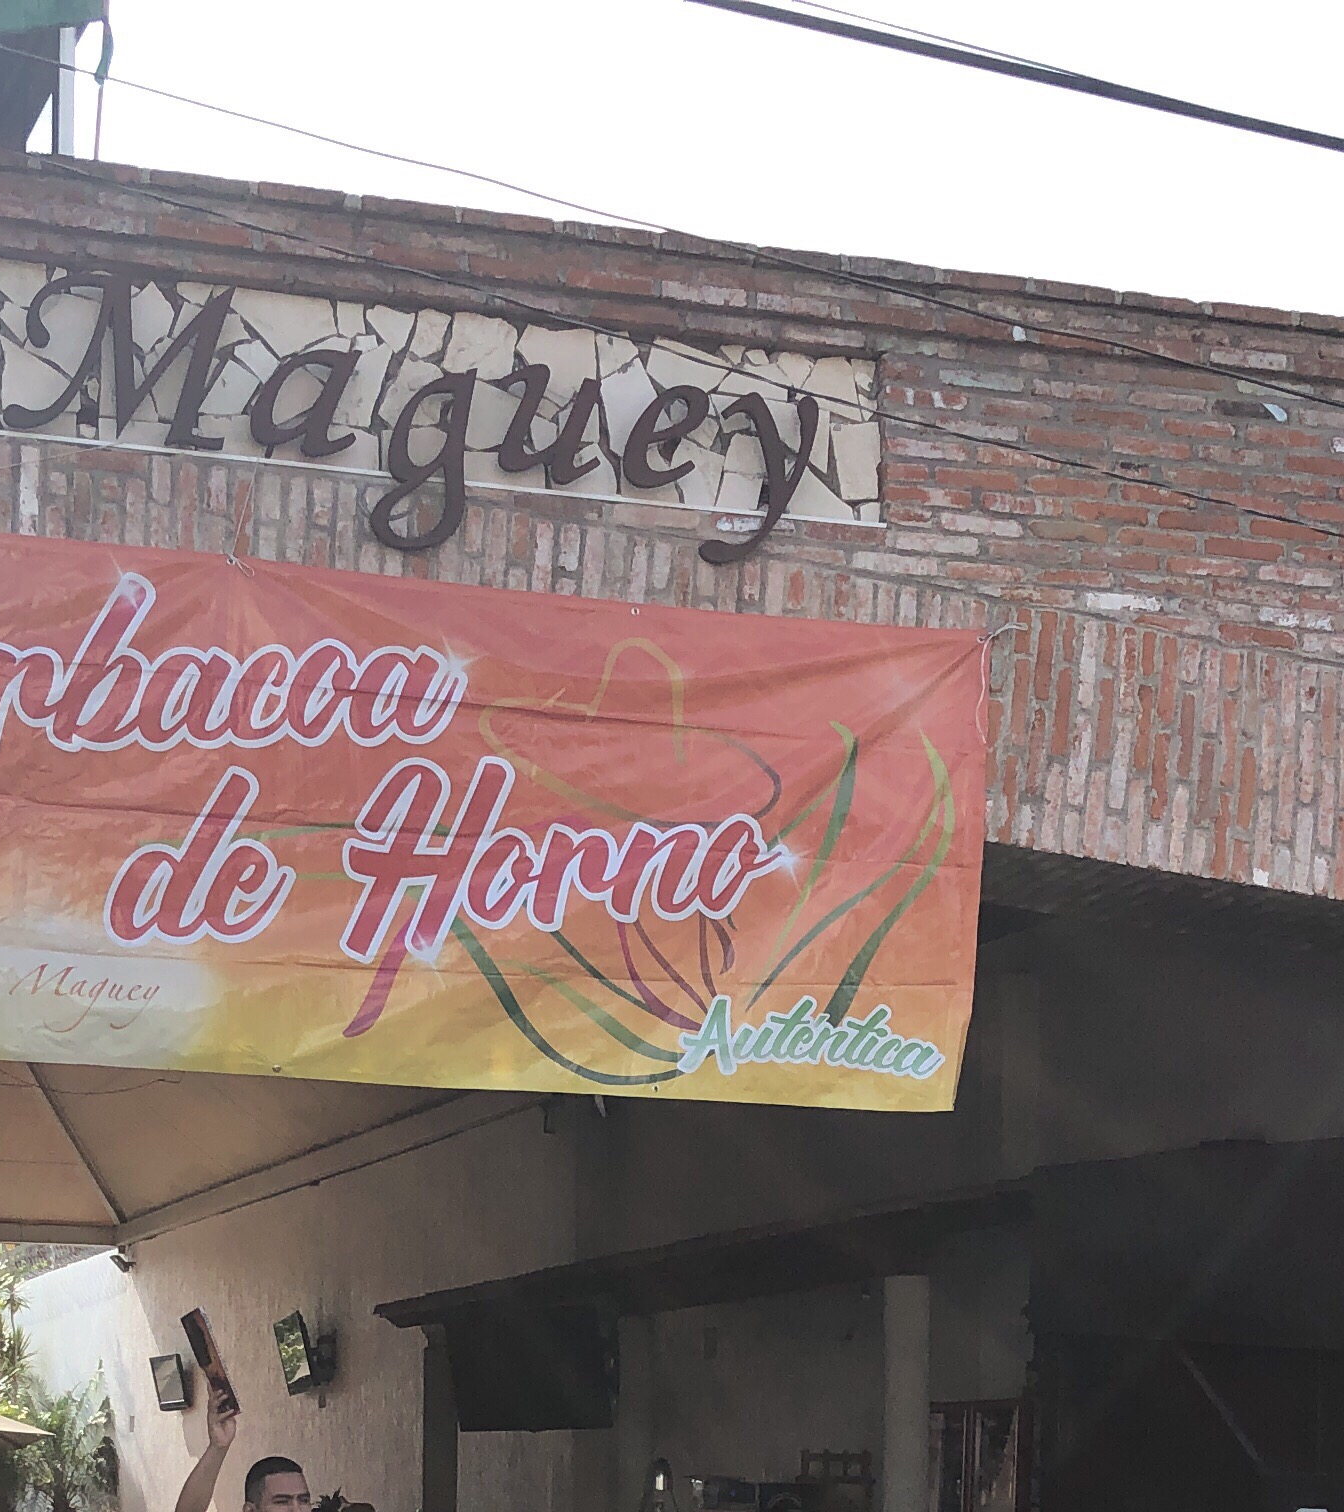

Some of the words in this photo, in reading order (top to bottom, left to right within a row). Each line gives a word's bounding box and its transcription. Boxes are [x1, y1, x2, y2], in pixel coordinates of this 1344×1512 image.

[3, 271, 820, 565] Maguey
[102, 765, 296, 947] de
[339, 756, 784, 964] Horno
[8, 963, 161, 1033] Maguey
